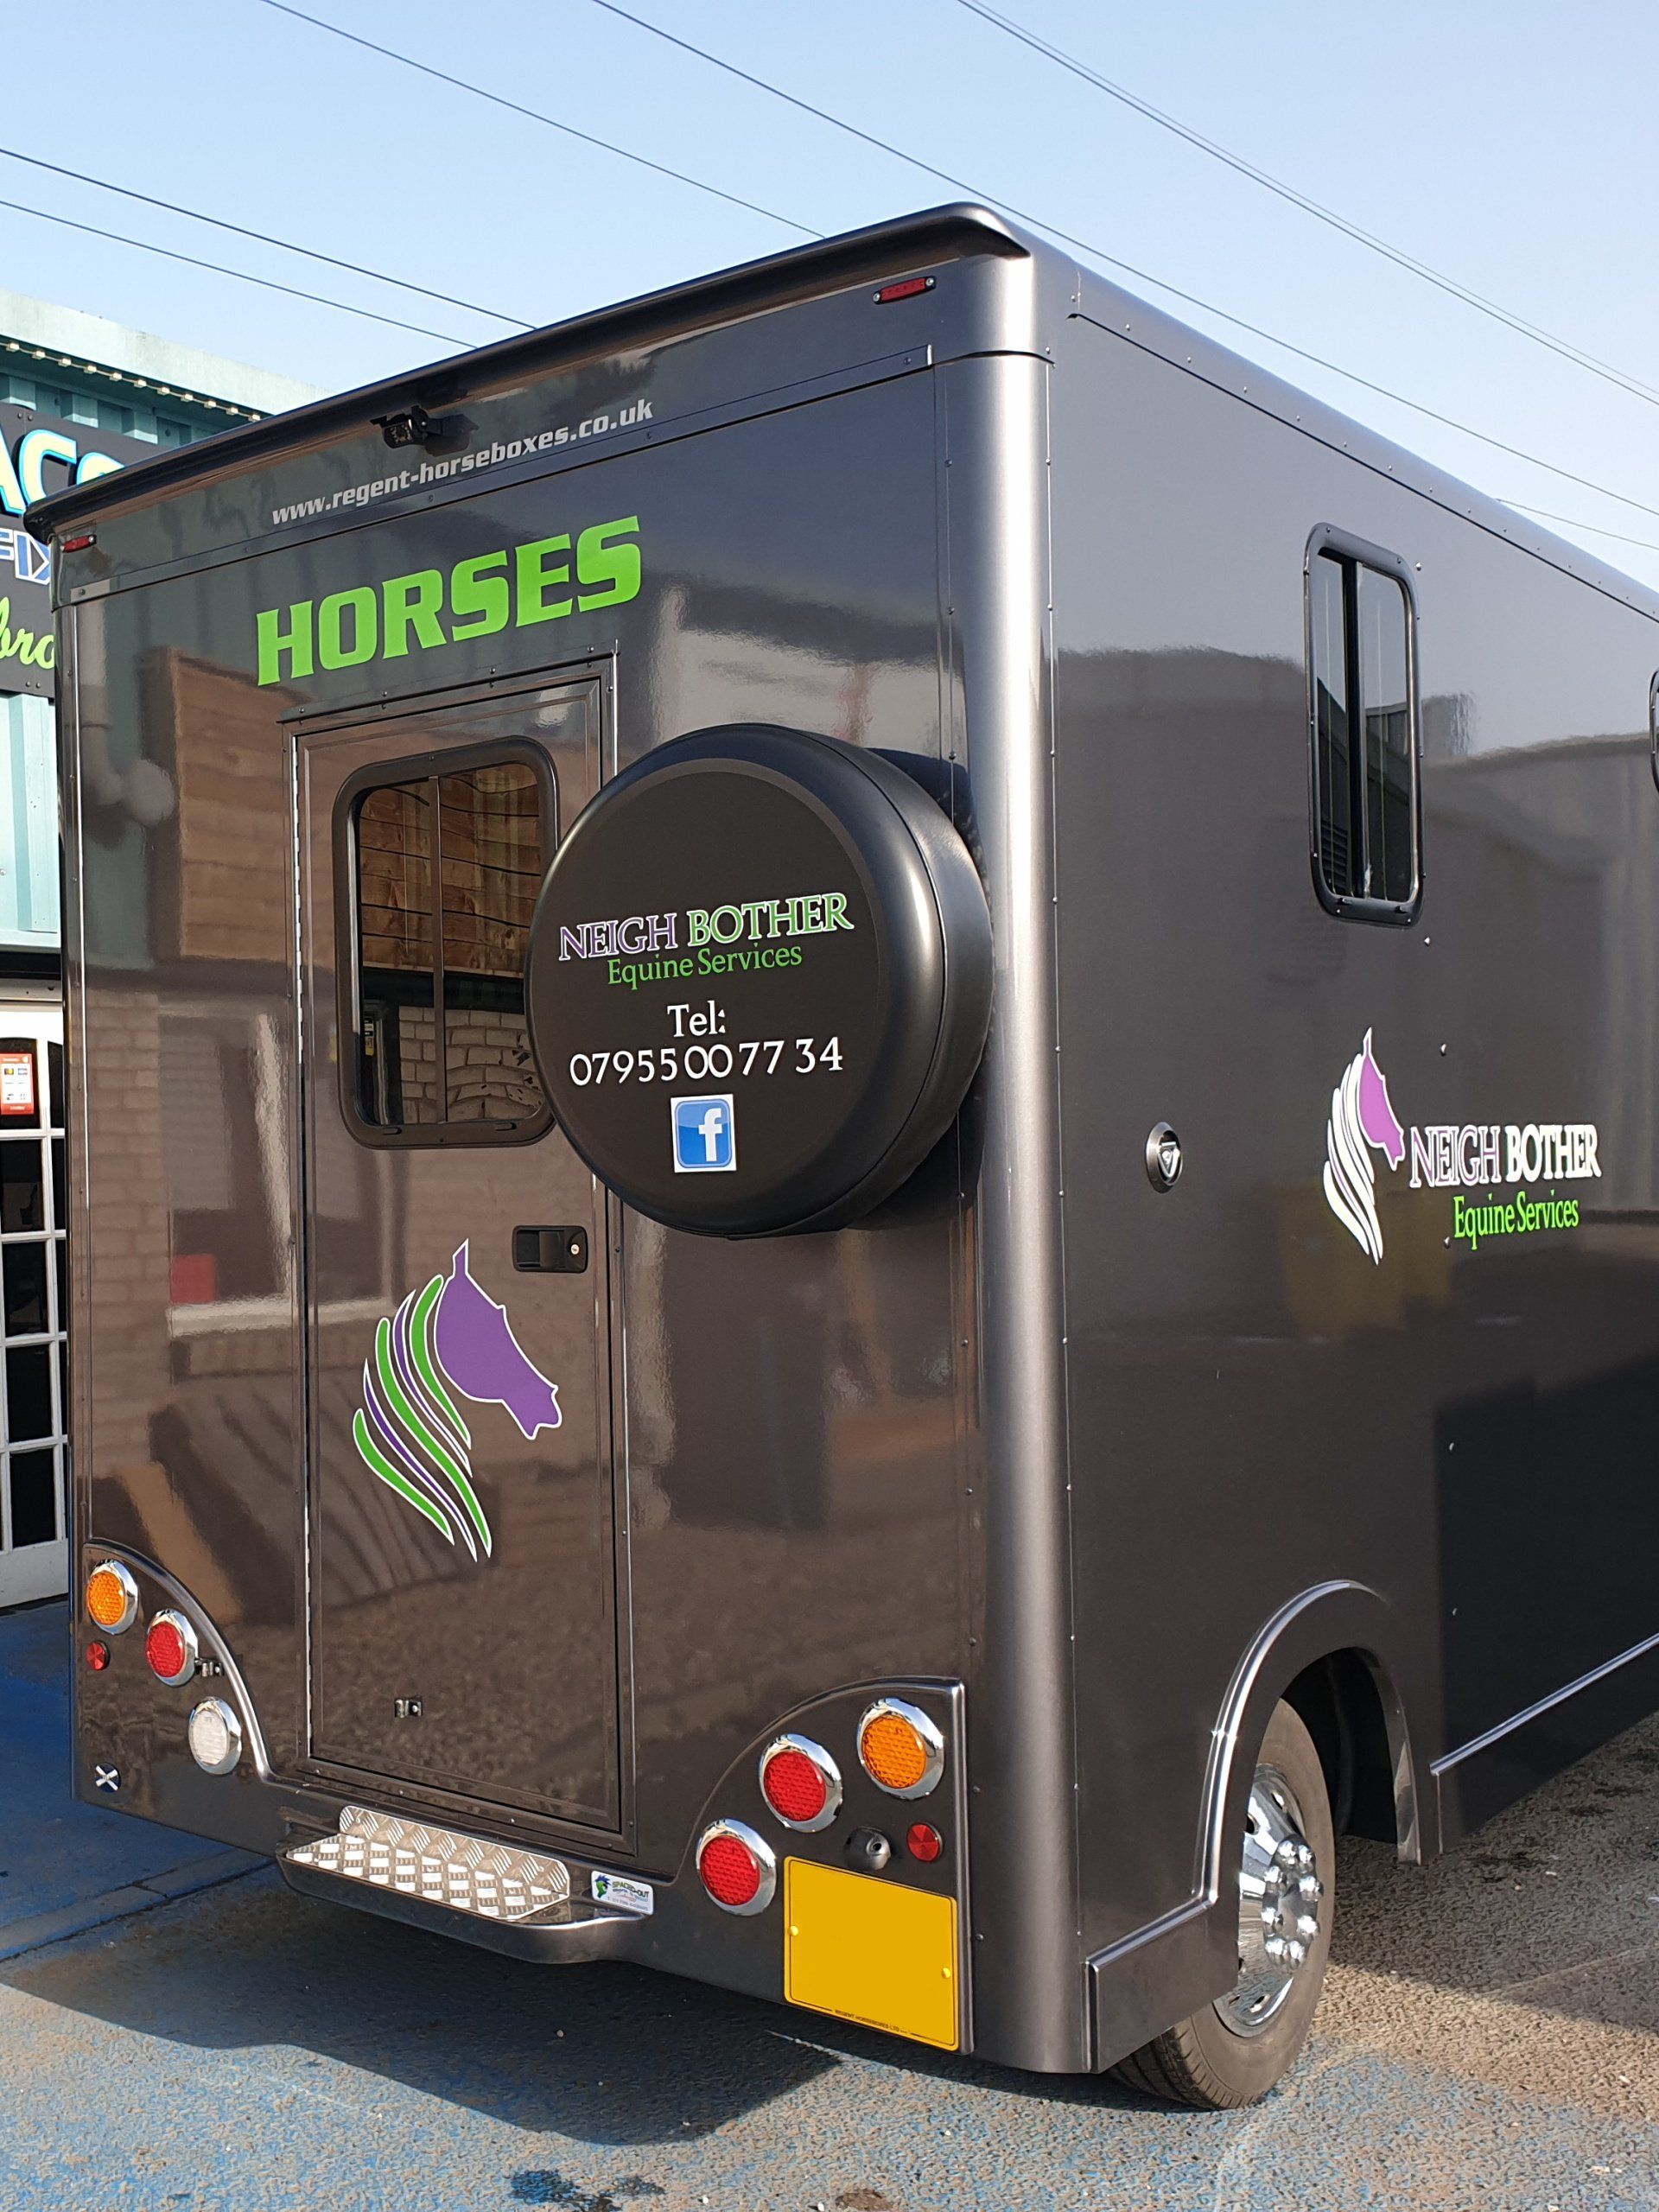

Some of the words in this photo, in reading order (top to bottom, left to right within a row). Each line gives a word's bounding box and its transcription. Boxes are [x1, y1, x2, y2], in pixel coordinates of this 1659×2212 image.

[271, 398, 653, 525] www.regent-horseboxes.co.uk
[257, 515, 641, 686] HORSES
[558, 912, 677, 961] NEIGH
[686, 892, 855, 948] BOTHER
[607, 953, 694, 990] Equine
[696, 942, 803, 976] Services
[666, 1000, 726, 1038] Tel:
[1408, 1125, 1502, 1189] NEIGH
[1505, 1123, 1602, 1183] BOTHER
[1452, 1192, 1516, 1250] Equine
[1516, 1189, 1580, 1233] Services
